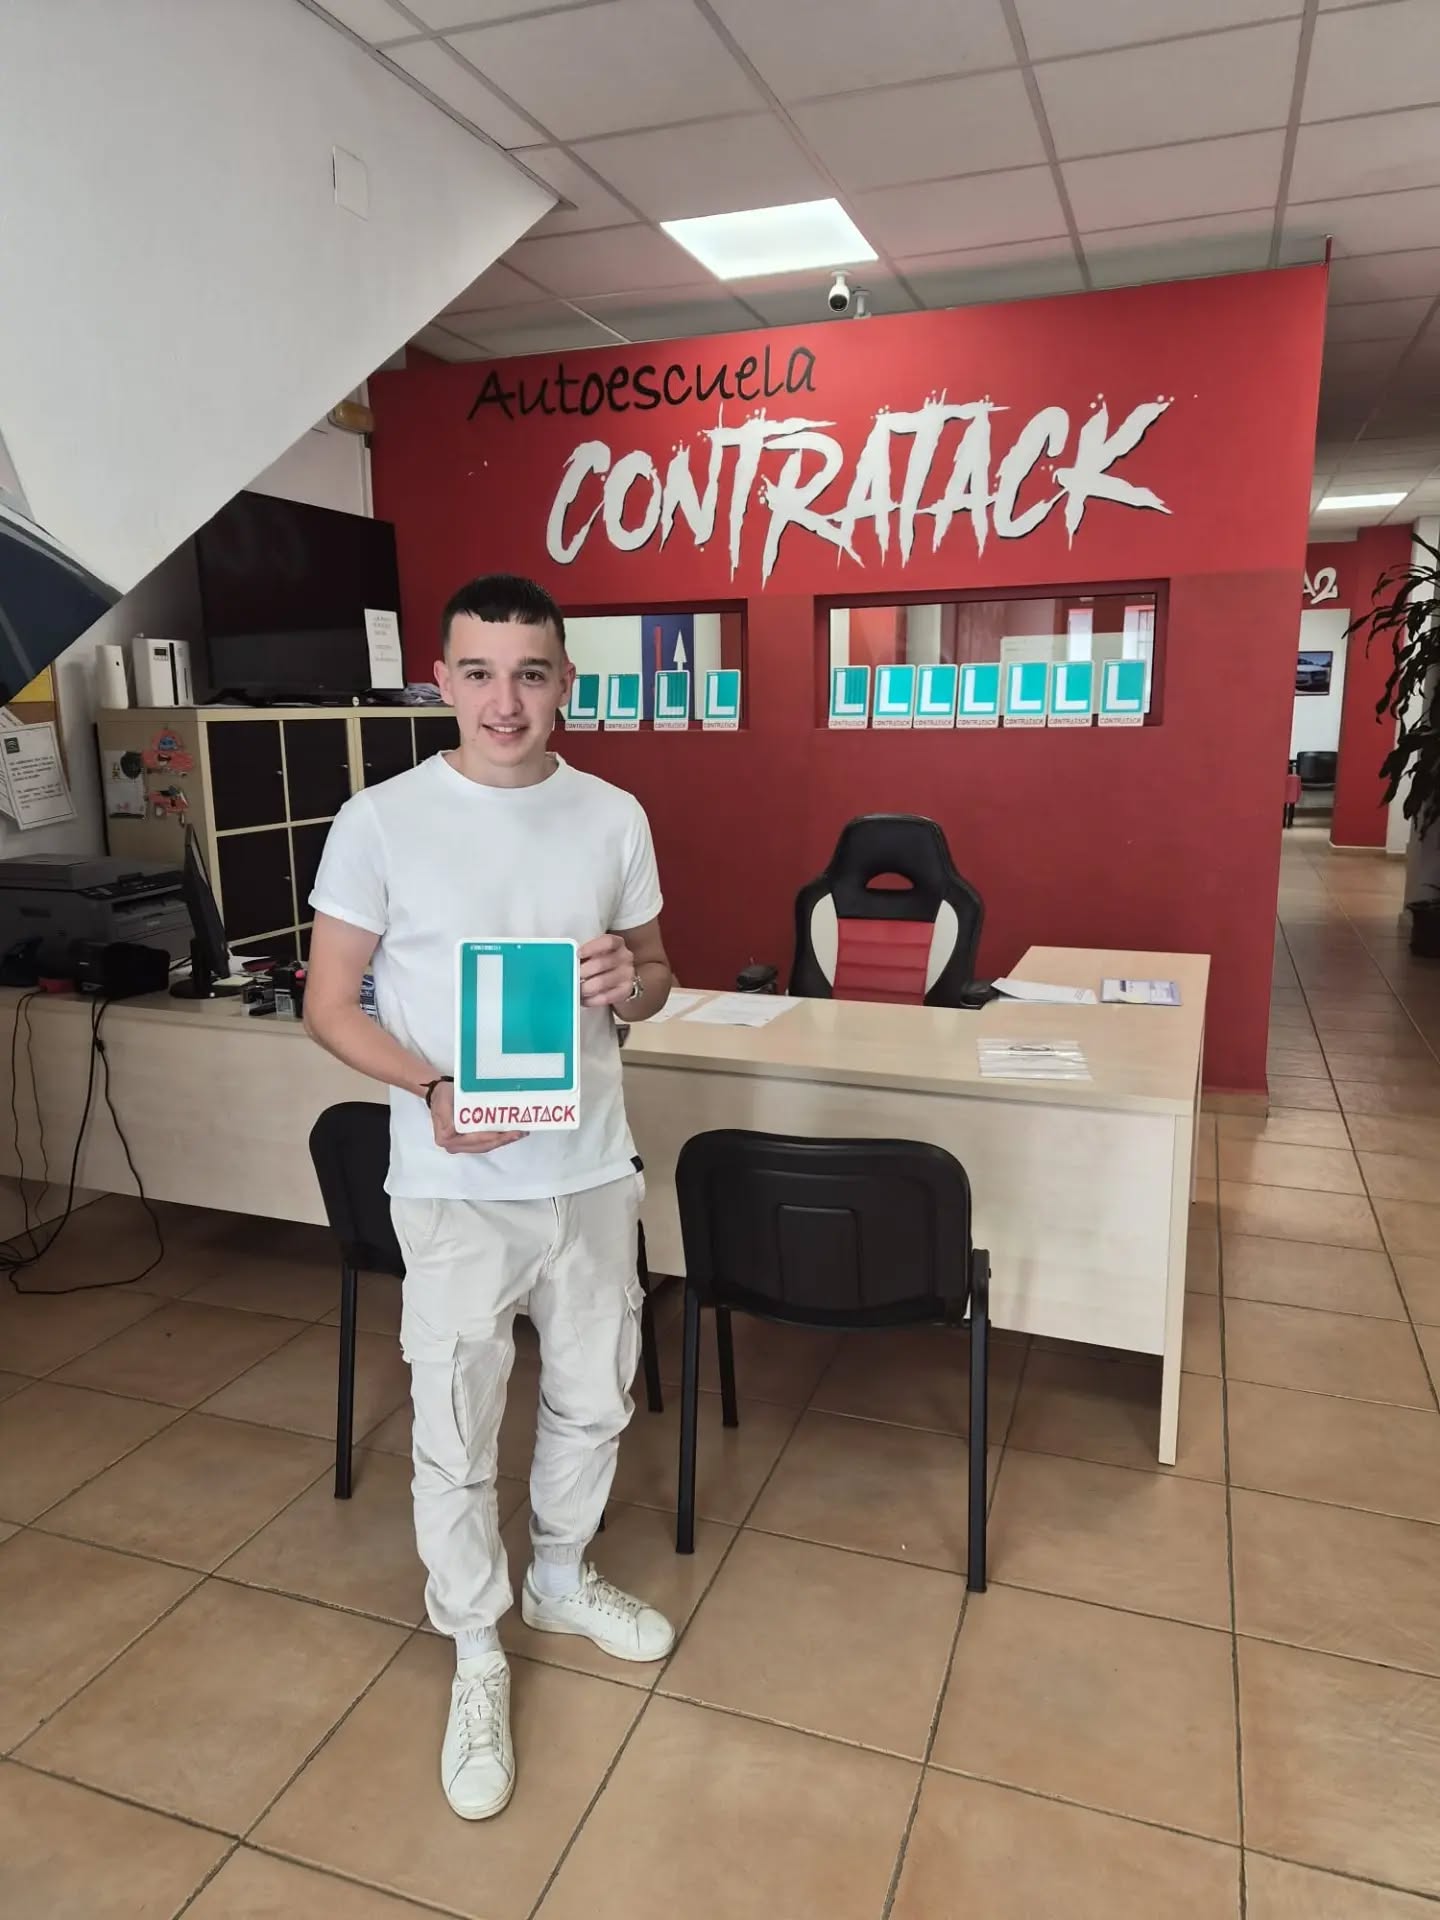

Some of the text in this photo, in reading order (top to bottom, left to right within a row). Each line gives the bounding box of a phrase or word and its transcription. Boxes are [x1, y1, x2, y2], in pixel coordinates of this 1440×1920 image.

[467, 344, 817, 421] Autoescuela
[545, 389, 1173, 590] CONTRATACK
[570, 677, 595, 717] L
[609, 677, 636, 717] L
[658, 676, 685, 716] L
[708, 675, 736, 715] L
[835, 671, 864, 713] L
[879, 670, 909, 712] L
[920, 670, 951, 712] L
[963, 669, 994, 712] L
[1010, 667, 1042, 710] L
[1055, 667, 1088, 710] L
[1106, 665, 1140, 710] L
[475, 953, 566, 1080] L
[459, 1105, 576, 1125] CONTRATACK
